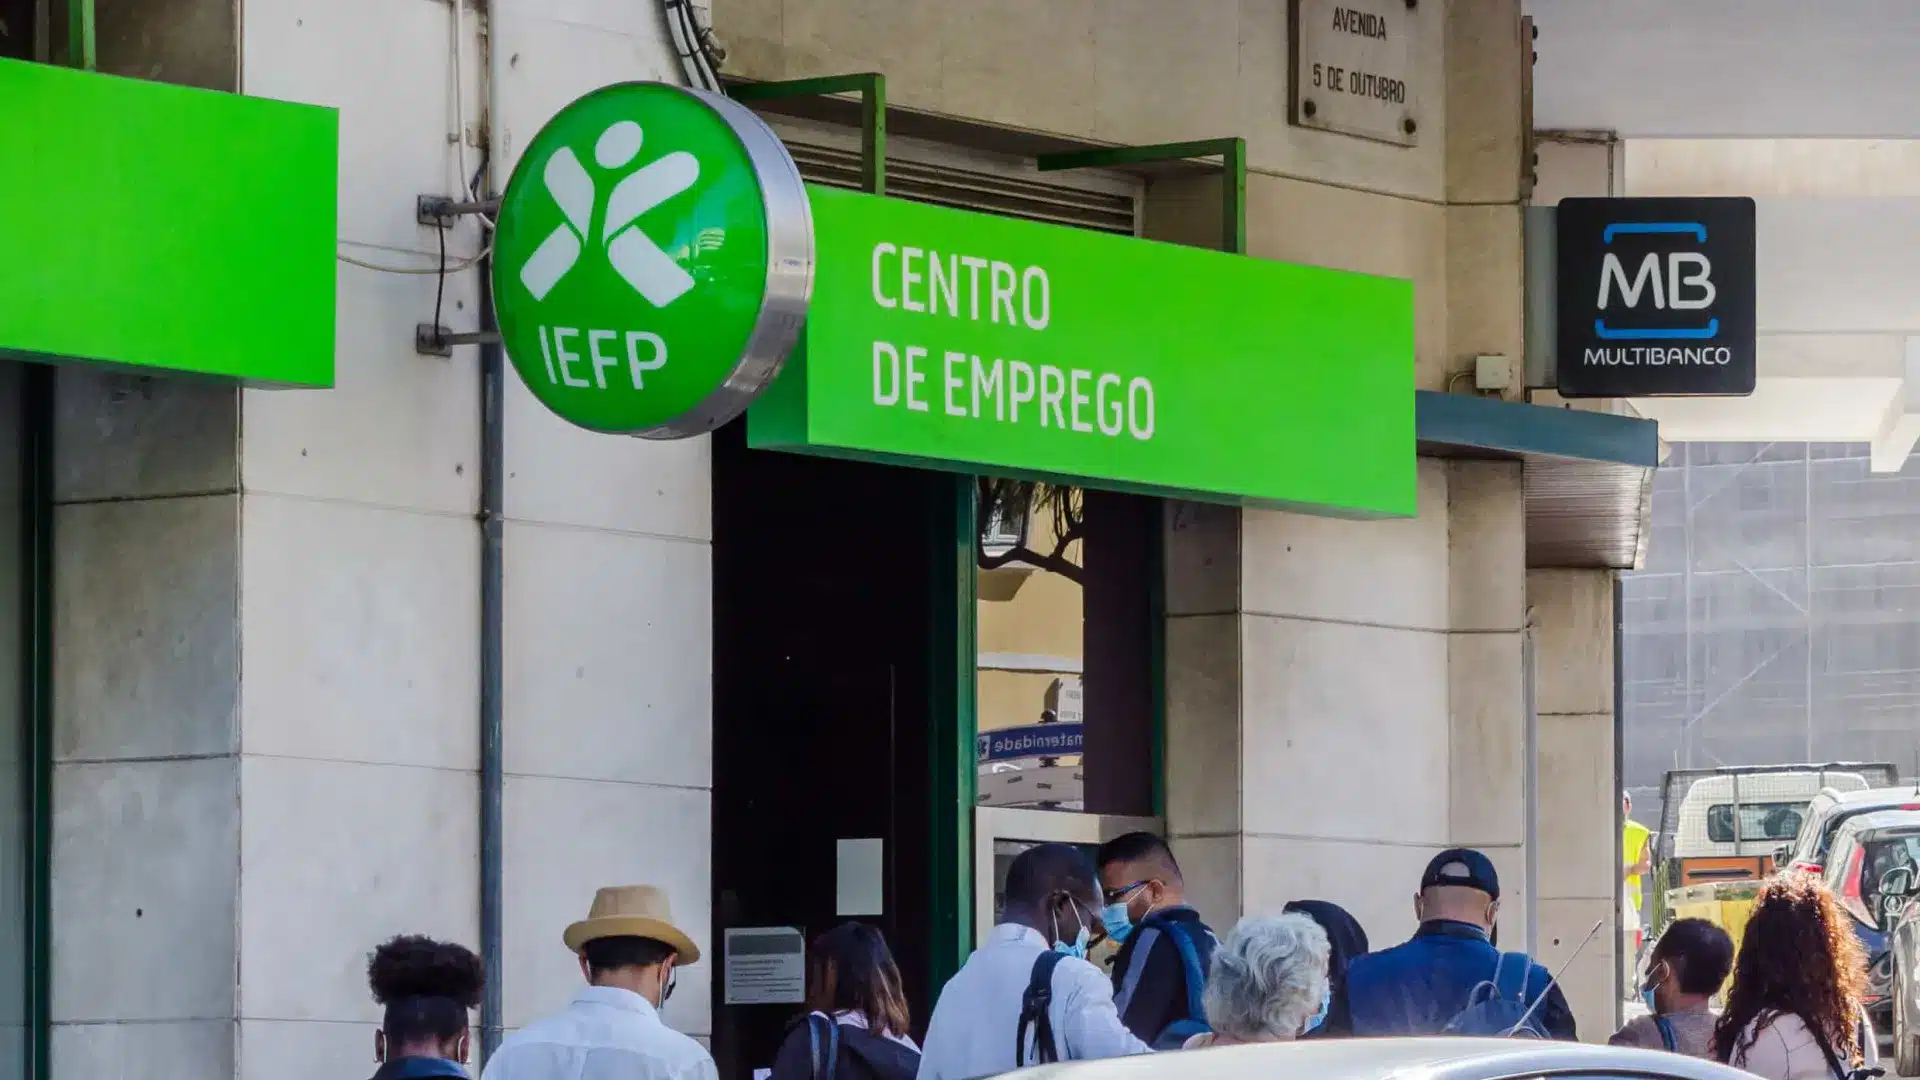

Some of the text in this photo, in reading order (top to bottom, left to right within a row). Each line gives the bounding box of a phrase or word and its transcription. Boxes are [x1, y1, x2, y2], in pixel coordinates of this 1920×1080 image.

[1333, 7, 1387, 41] AVENIDA
[1313, 63, 1405, 104] 5 DE OUTUBRO
[872, 242, 1050, 331] CENTRO
[1597, 252, 1716, 310] MB
[538, 324, 668, 390] IEFP
[1584, 347, 1731, 366] MULTIBANCO
[872, 341, 1155, 440] DE EMPREGO
